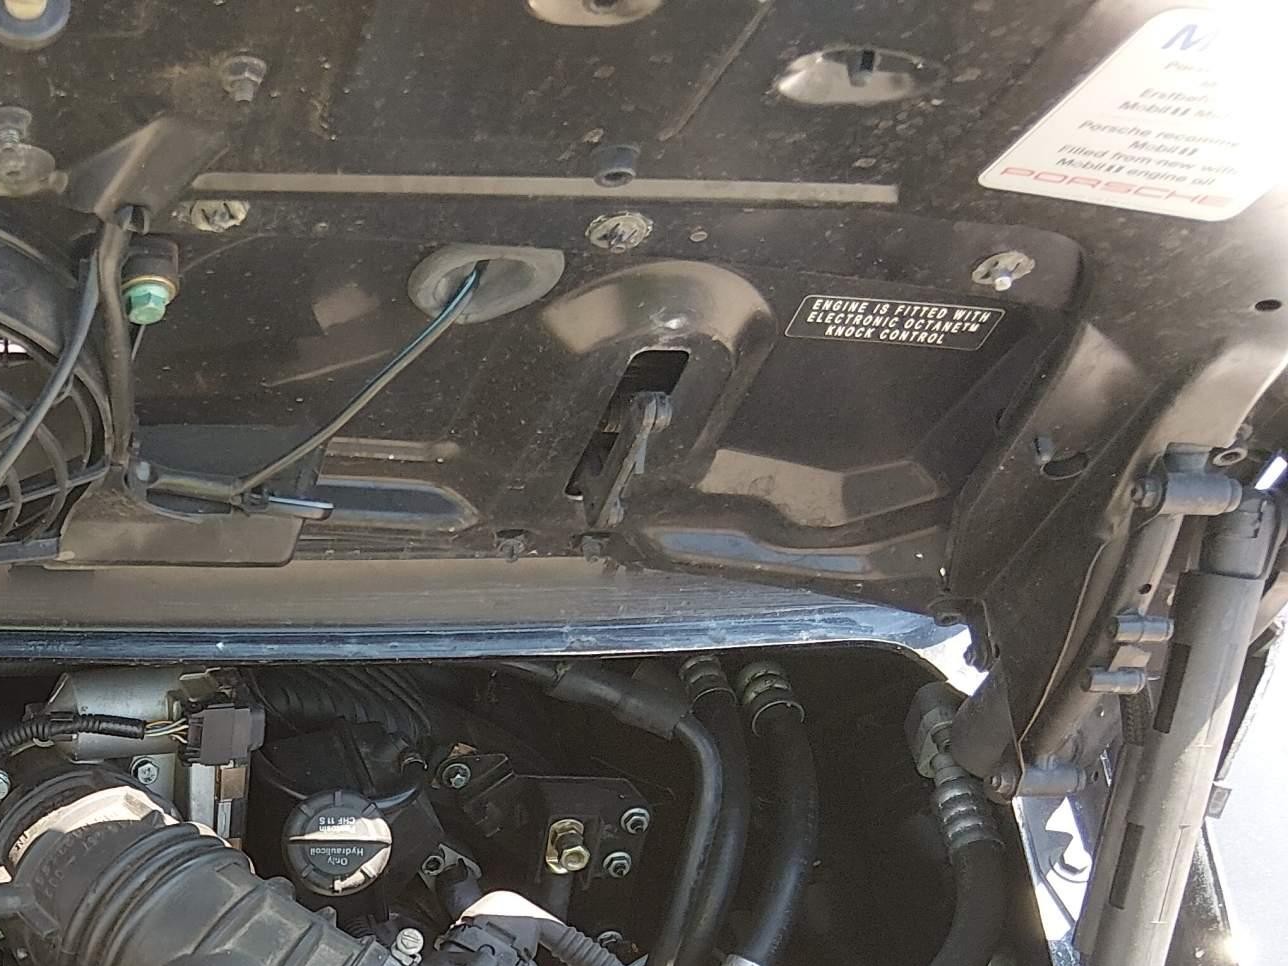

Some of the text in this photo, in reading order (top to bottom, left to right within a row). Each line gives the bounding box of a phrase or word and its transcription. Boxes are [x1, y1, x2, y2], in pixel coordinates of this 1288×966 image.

[1000, 166, 1233, 207] PORSCHE
[812, 299, 992, 322] ENGINE IS FITTED WITH
[806, 312, 899, 328] ELECTRONIC
[825, 326, 944, 344] KNOCK CONTROL
[310, 848, 364, 856] Hydraulicoil
[328, 857, 348, 865] Only
